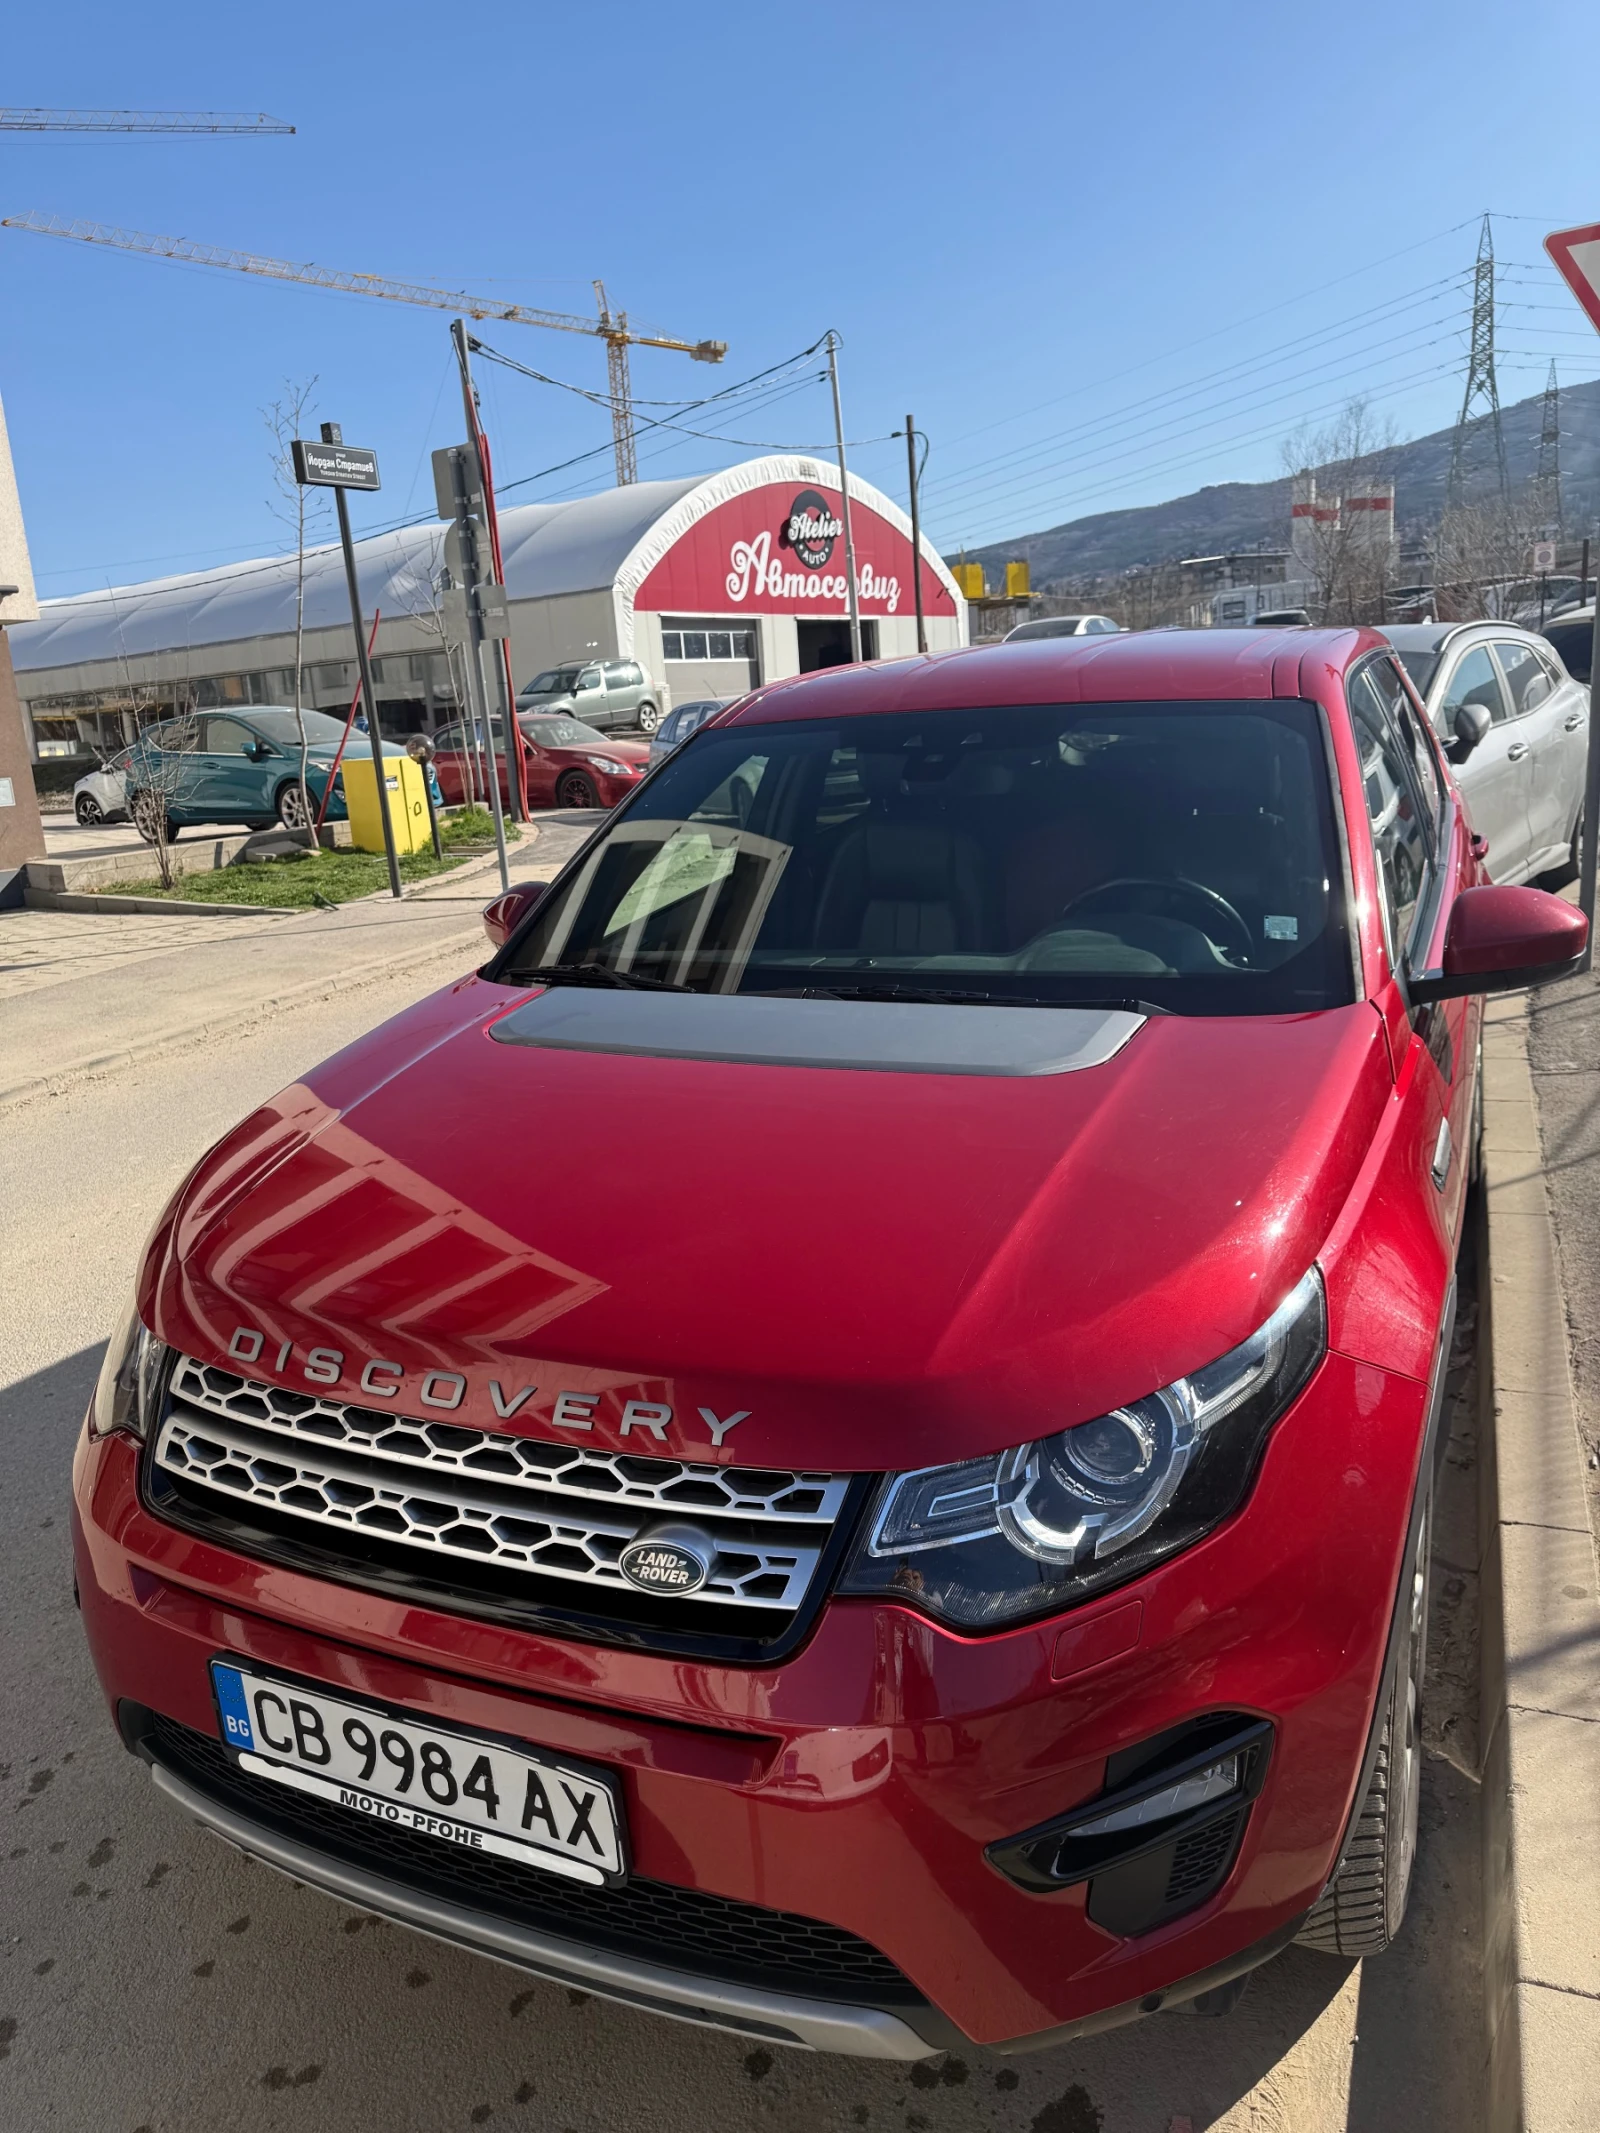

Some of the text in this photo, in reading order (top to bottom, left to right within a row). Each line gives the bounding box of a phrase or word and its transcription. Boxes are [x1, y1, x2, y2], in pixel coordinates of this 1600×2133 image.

[307, 452, 335, 469] Йордан
[335, 458, 374, 473] Стратиев
[787, 511, 844, 542] Atelier
[801, 550, 827, 565] AUTO
[228, 1325, 752, 1447] DISCOVERY
[636, 1550, 678, 1569] LAND
[638, 1565, 690, 1585] ROVER
[226, 1714, 251, 1738] BG
[252, 1689, 606, 1858] CB 9984 AX
